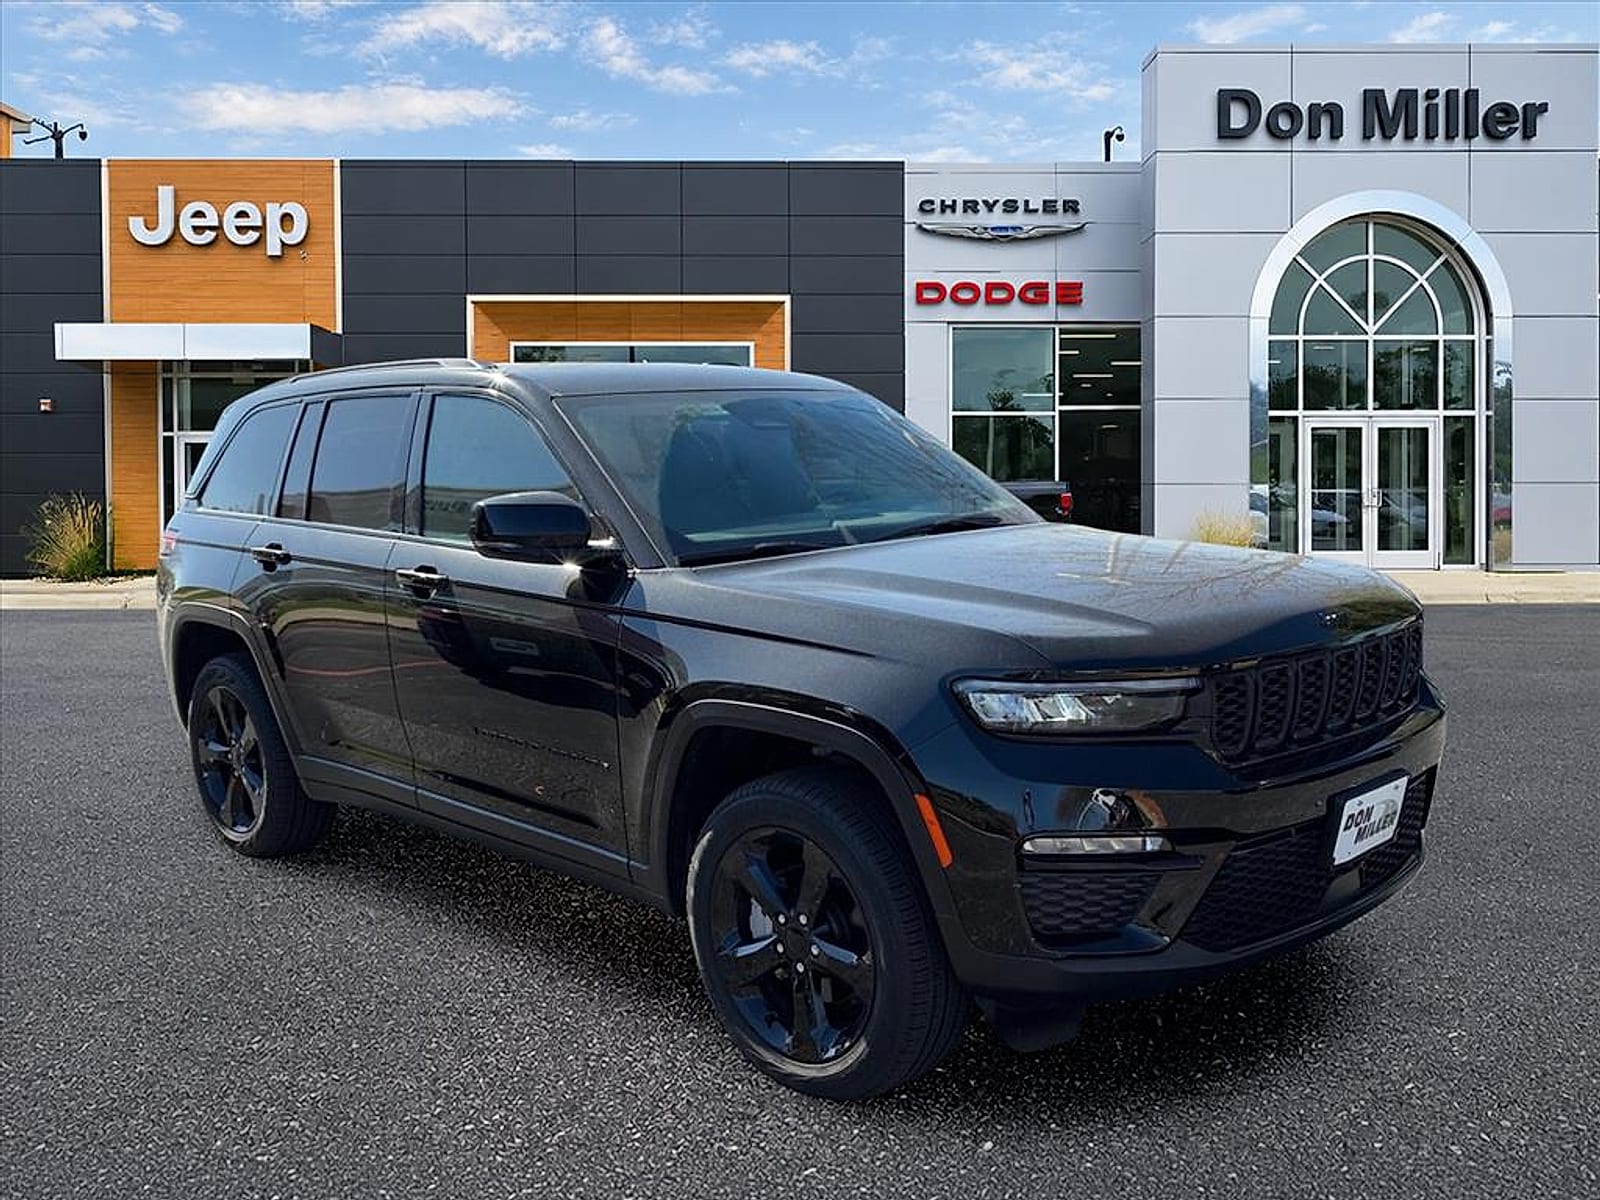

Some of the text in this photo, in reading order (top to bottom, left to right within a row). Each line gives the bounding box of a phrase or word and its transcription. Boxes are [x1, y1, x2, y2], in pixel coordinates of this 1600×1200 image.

[1217, 88, 1549, 141] Don Miller
[918, 199, 1081, 215] CHRYSLER
[128, 185, 309, 257] Jeep
[916, 282, 1083, 305] DODGE
[1343, 804, 1375, 831] DON
